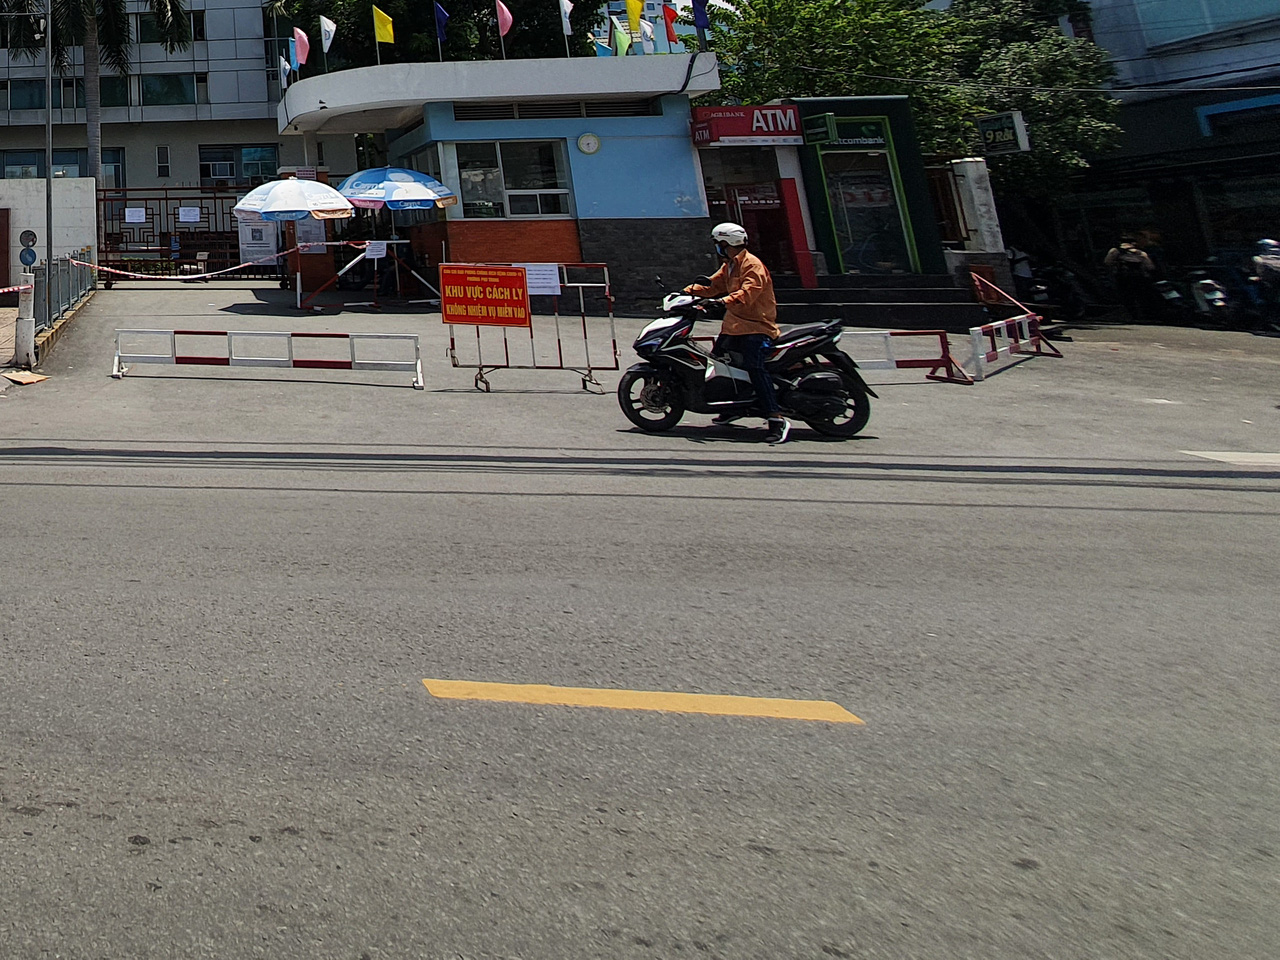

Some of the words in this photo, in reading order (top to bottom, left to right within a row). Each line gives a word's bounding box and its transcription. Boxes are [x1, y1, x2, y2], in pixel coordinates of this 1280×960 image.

[752, 109, 797, 132] ATM
[695, 130, 710, 142] ATM
[445, 285, 464, 298] KHU
[465, 285, 484, 301] VỰC
[486, 284, 510, 300] CÁCH
[512, 288, 523, 301] LY
[446, 302, 467, 316] KHÔNG
[488, 305, 496, 320] VỤ
